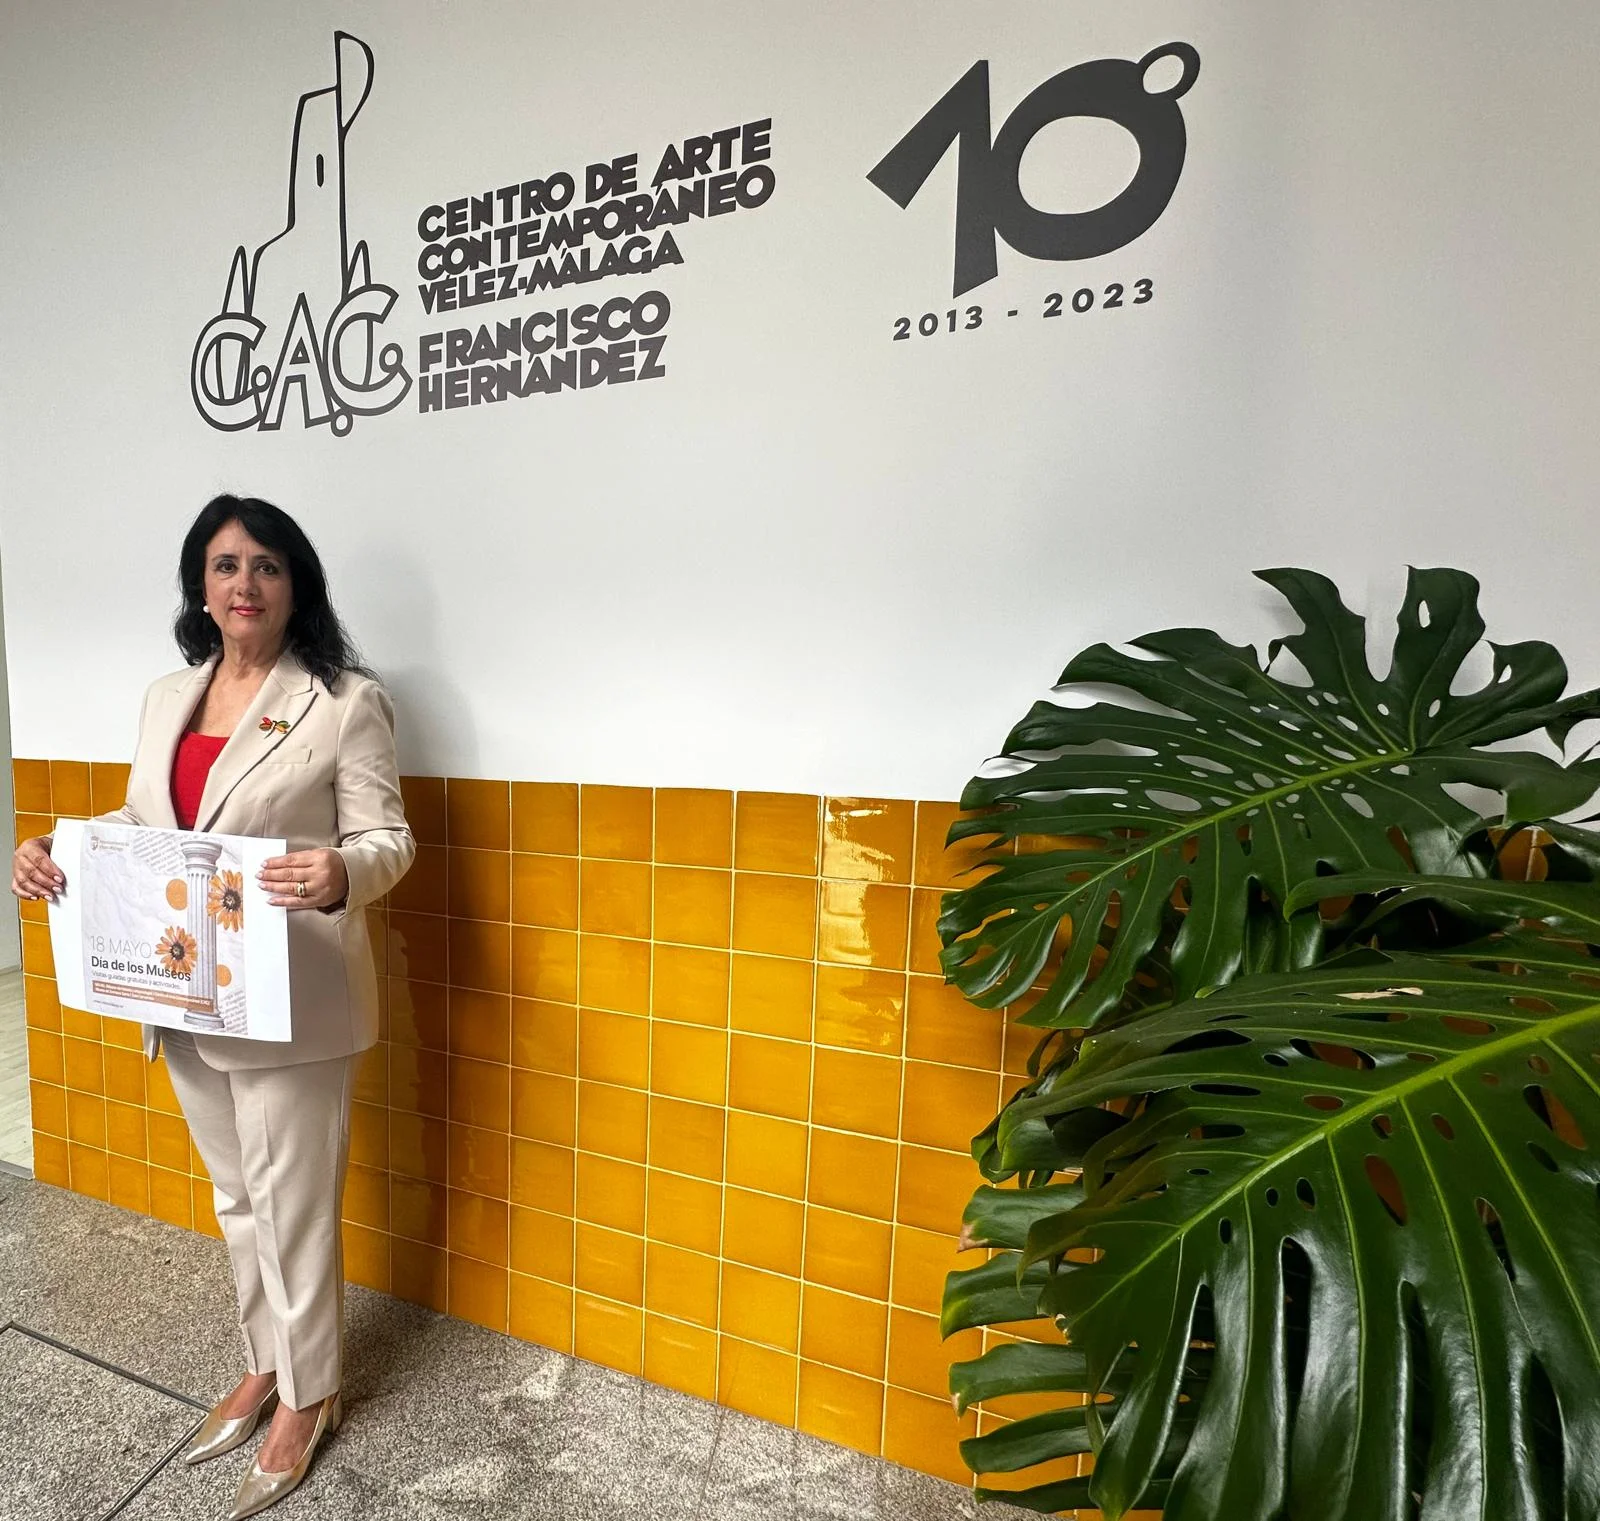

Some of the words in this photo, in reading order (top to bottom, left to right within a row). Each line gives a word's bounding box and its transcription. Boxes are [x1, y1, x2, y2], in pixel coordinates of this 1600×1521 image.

[418, 172, 575, 242] CENTRO
[585, 153, 638, 203] DE
[651, 118, 772, 187] ARTE
[418, 164, 775, 280] CONTEMPORÁNEO
[418, 230, 684, 315] VÉLEZ-MÁLAGA
[893, 305, 983, 341] 2013
[1043, 278, 1153, 318] 2023
[419, 290, 671, 373] FRANCISCO
[419, 335, 667, 413] HERNÁNDEZ
[90, 935, 105, 953] 18
[109, 938, 152, 959] MAYO
[91, 955, 109, 969] Día
[111, 959, 125, 972] de
[127, 961, 144, 974] los
[146, 964, 192, 982] Museos
